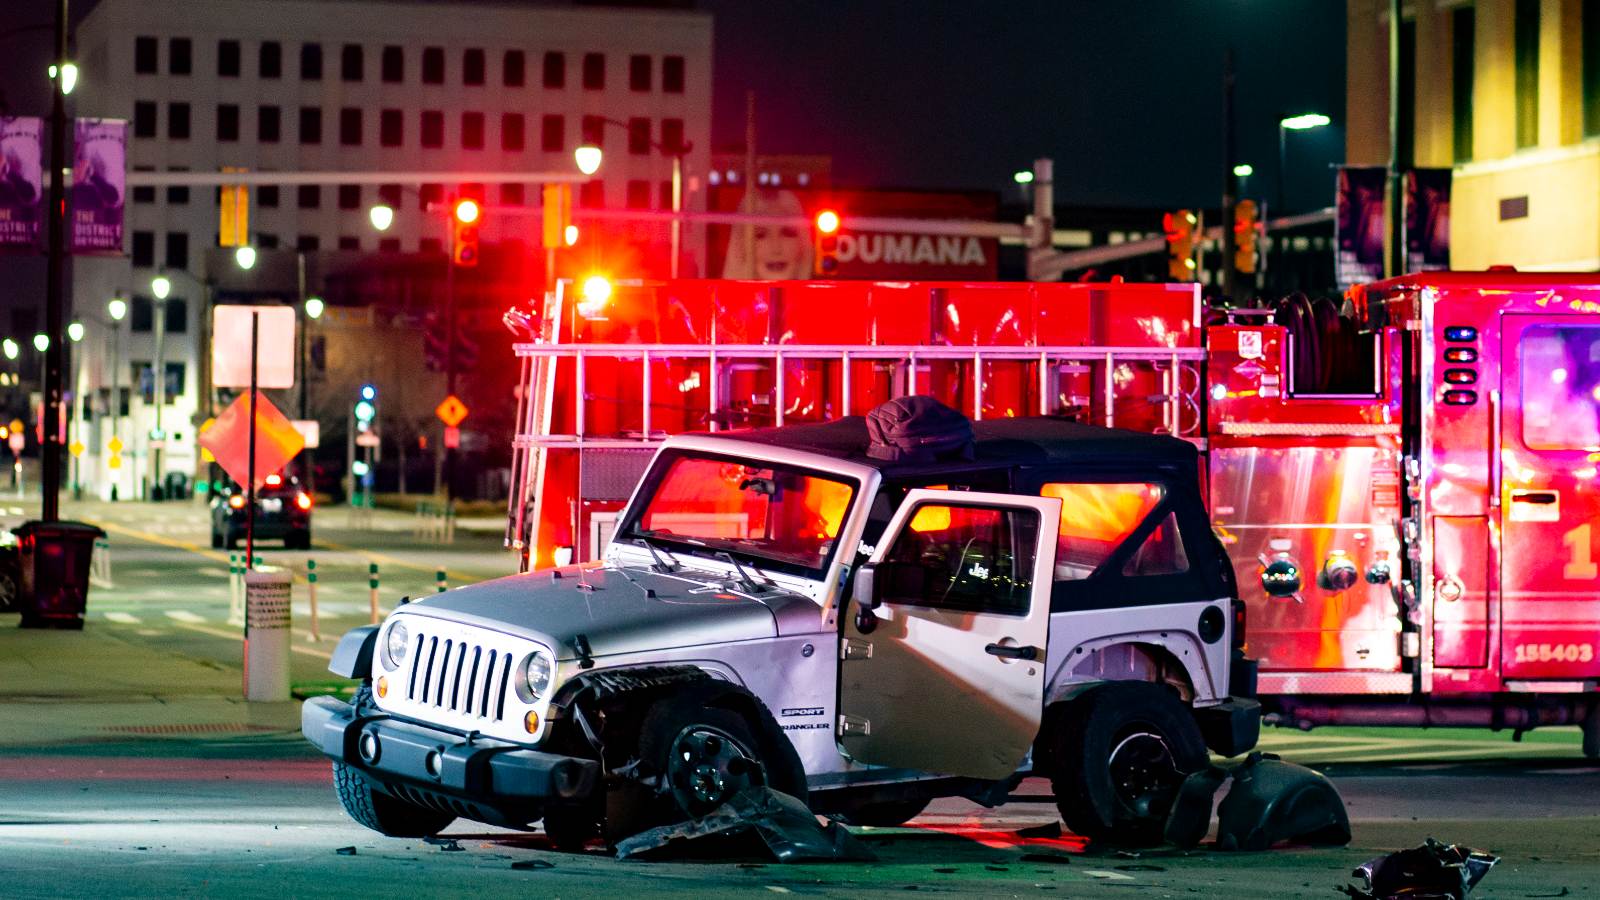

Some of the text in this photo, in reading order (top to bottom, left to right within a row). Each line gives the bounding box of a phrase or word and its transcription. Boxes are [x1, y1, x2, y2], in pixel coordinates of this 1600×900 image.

[76, 210, 94, 223] THE
[75, 224, 121, 237] DISTRICT
[836, 234, 986, 265] OUMANA
[857, 539, 875, 556] Jee
[1562, 523, 1598, 580] 1
[1515, 643, 1593, 663] 155403
[782, 708, 824, 716] SPORT
